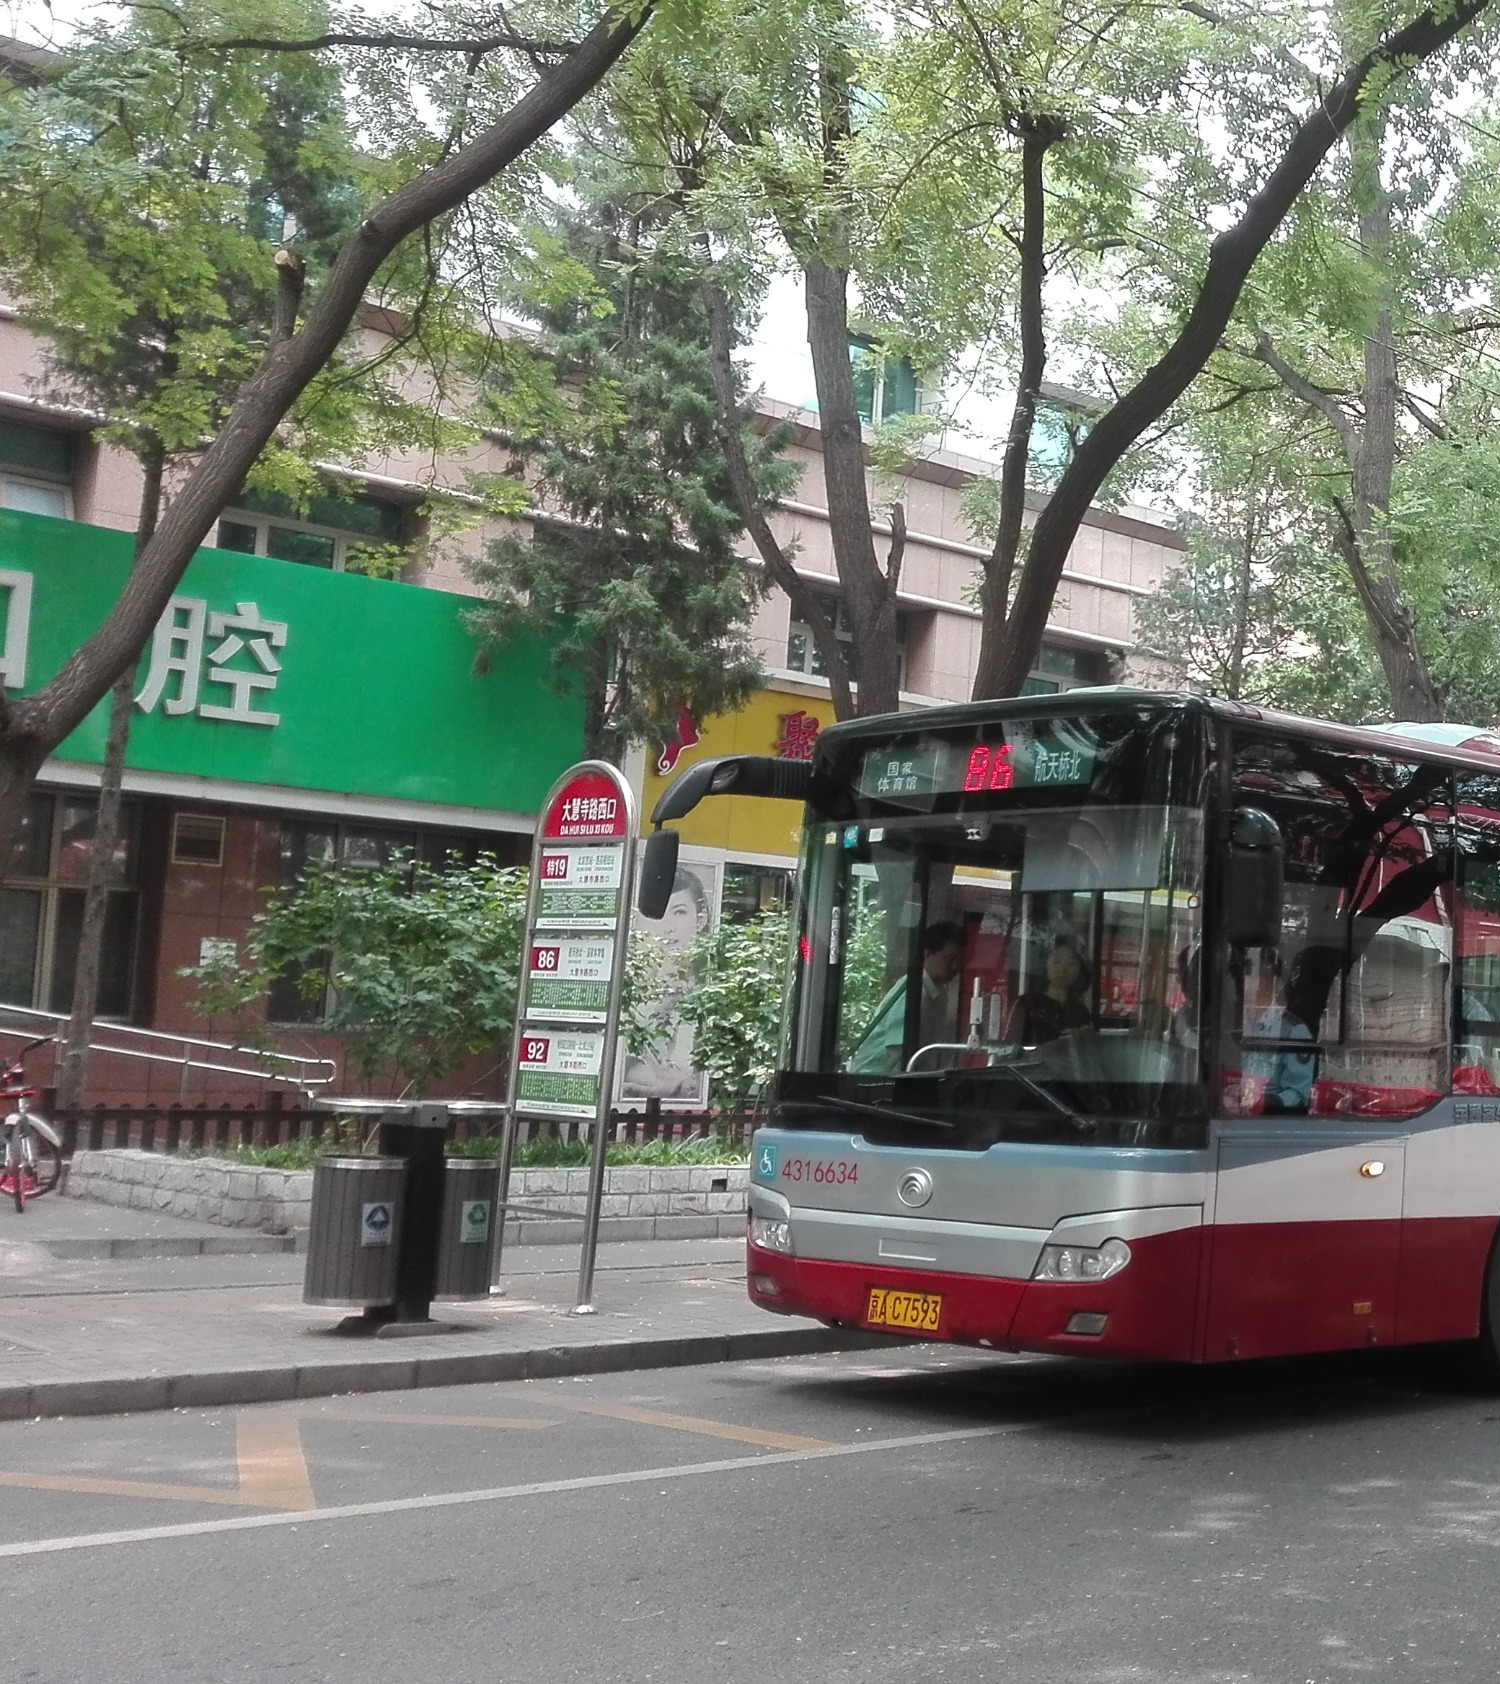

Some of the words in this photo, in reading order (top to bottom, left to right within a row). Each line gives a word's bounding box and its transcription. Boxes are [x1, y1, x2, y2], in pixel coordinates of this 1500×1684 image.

[886, 761, 913, 777] 国家
[963, 744, 1014, 791] 86
[1034, 750, 1081, 782] 航天桥北
[877, 776, 918, 792] 体育馆
[561, 797, 617, 821] 大慧寺路西口
[546, 858, 566, 876] 特19
[537, 950, 555, 968] 86
[527, 1041, 545, 1060] 92
[782, 1159, 859, 1185] 4316634
